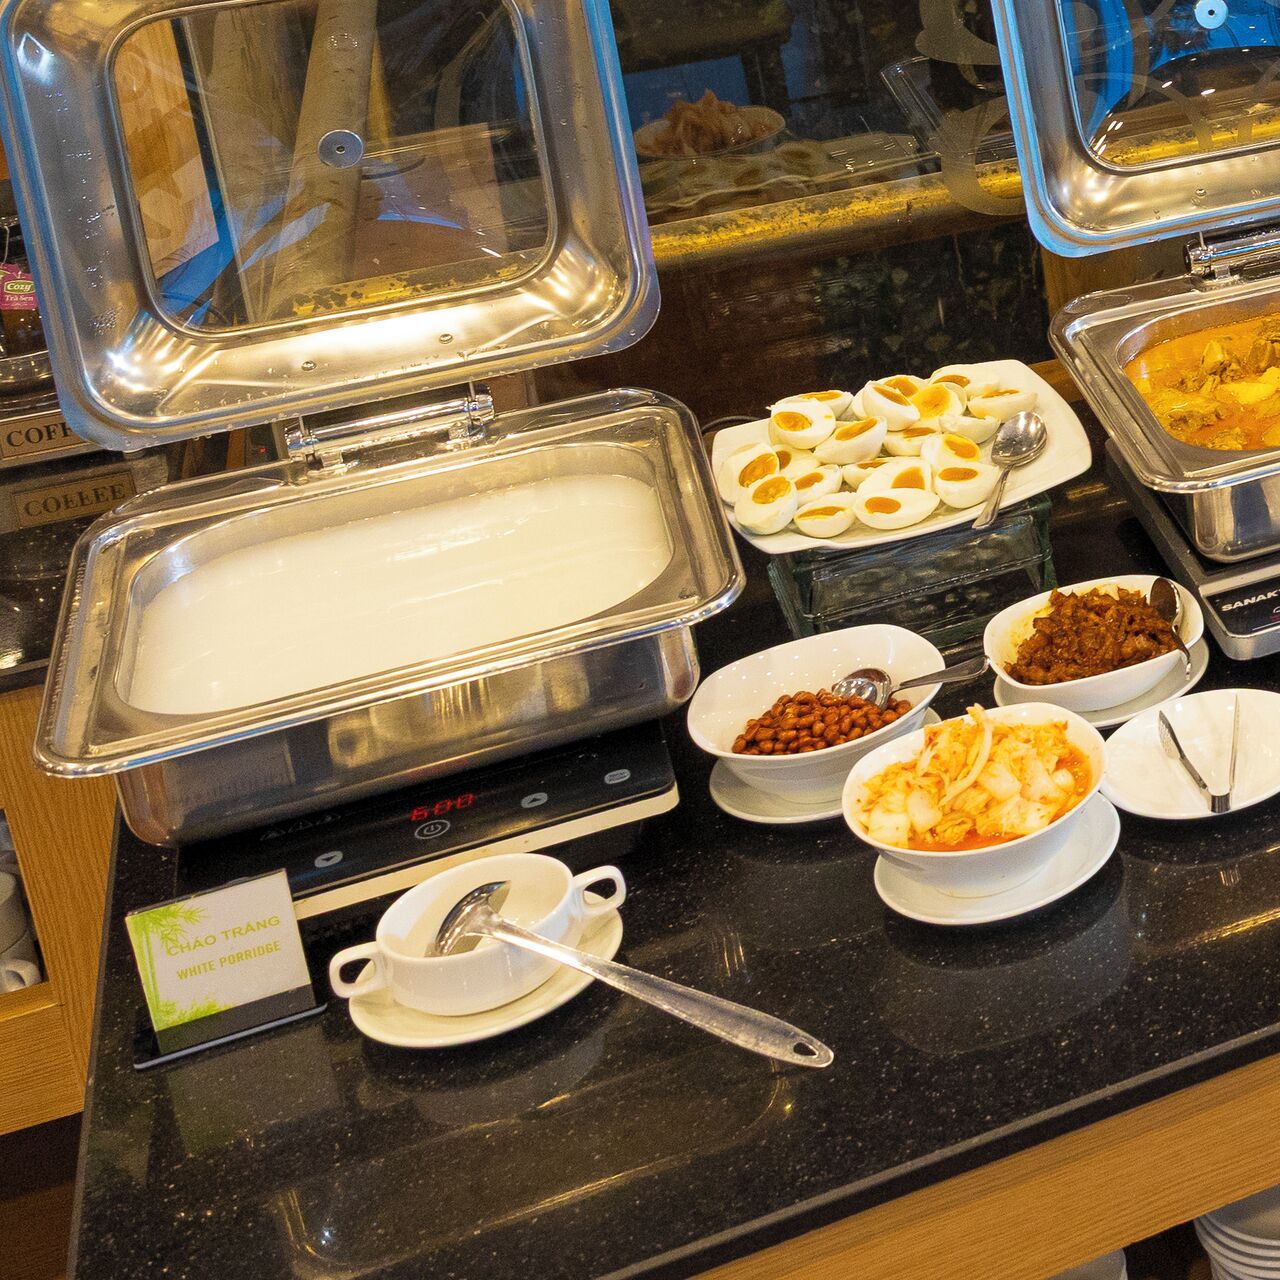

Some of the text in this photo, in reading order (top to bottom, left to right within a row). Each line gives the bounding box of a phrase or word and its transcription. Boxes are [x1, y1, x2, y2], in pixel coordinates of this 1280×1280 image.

[7, 283, 32, 292] Cozy
[410, 792, 476, 821] 600
[175, 940, 281, 980] WHITE PORRIDGE
